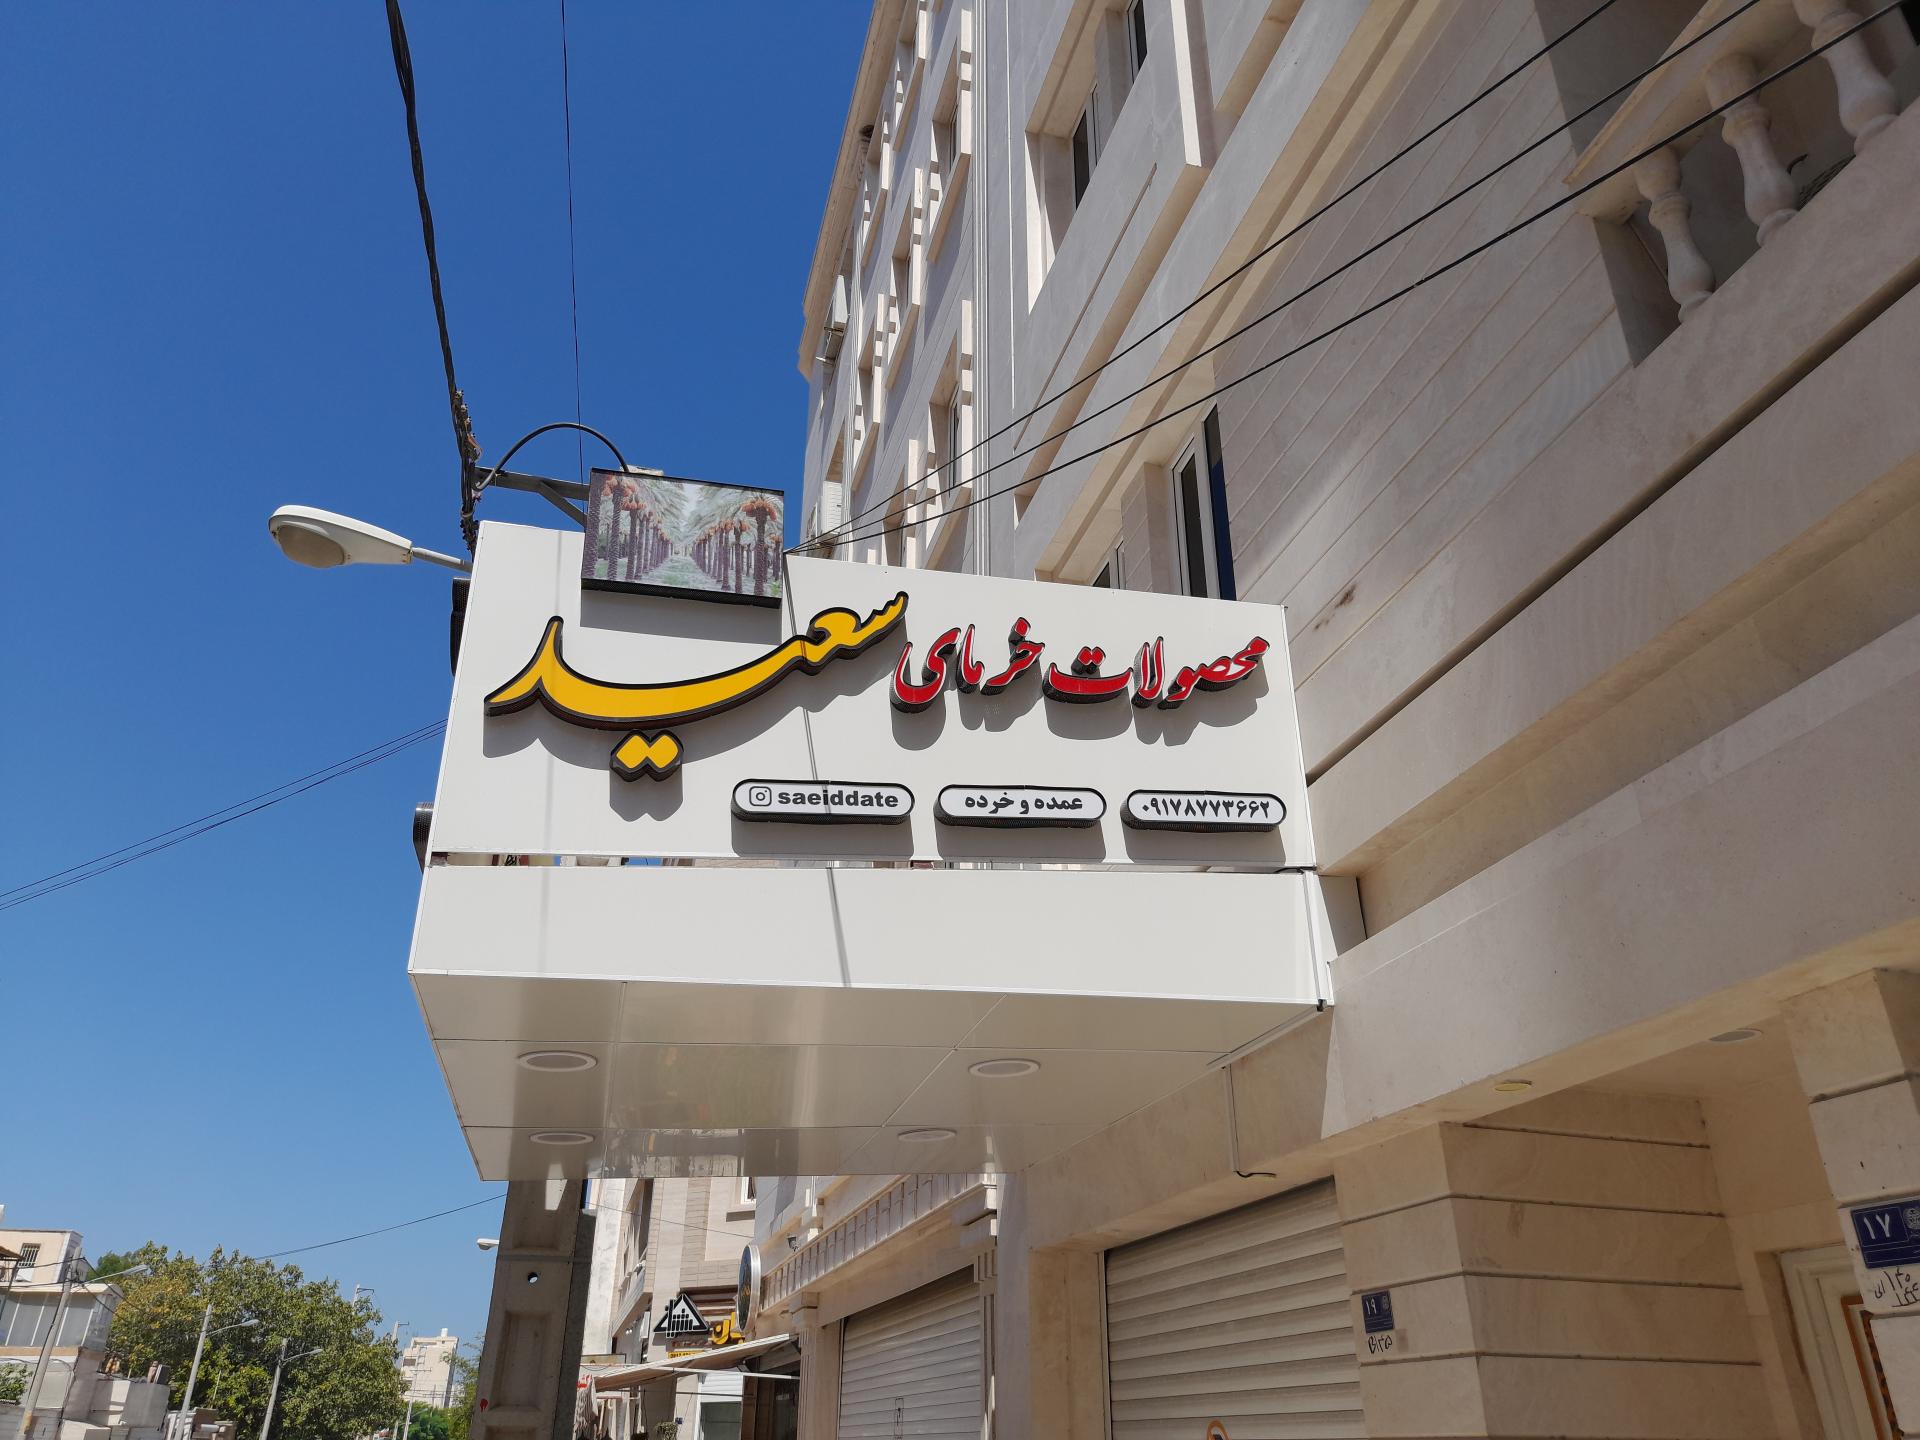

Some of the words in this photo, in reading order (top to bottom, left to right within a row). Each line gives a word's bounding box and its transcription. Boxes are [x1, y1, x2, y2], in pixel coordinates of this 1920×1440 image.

[893, 617, 1046, 706] خرمای
[1046, 636, 1271, 706] محصولات
[484, 591, 909, 779] سعید
[777, 789, 899, 808] saeiddate
[964, 791, 1015, 814] خرده
[1019, 799, 1030, 815] و
[1034, 796, 1083, 811] عمده
[1141, 797, 1270, 819] ۰۹۱۷۸۷۷۳۶۶۲
[1863, 1212, 1891, 1240] ۱۷
